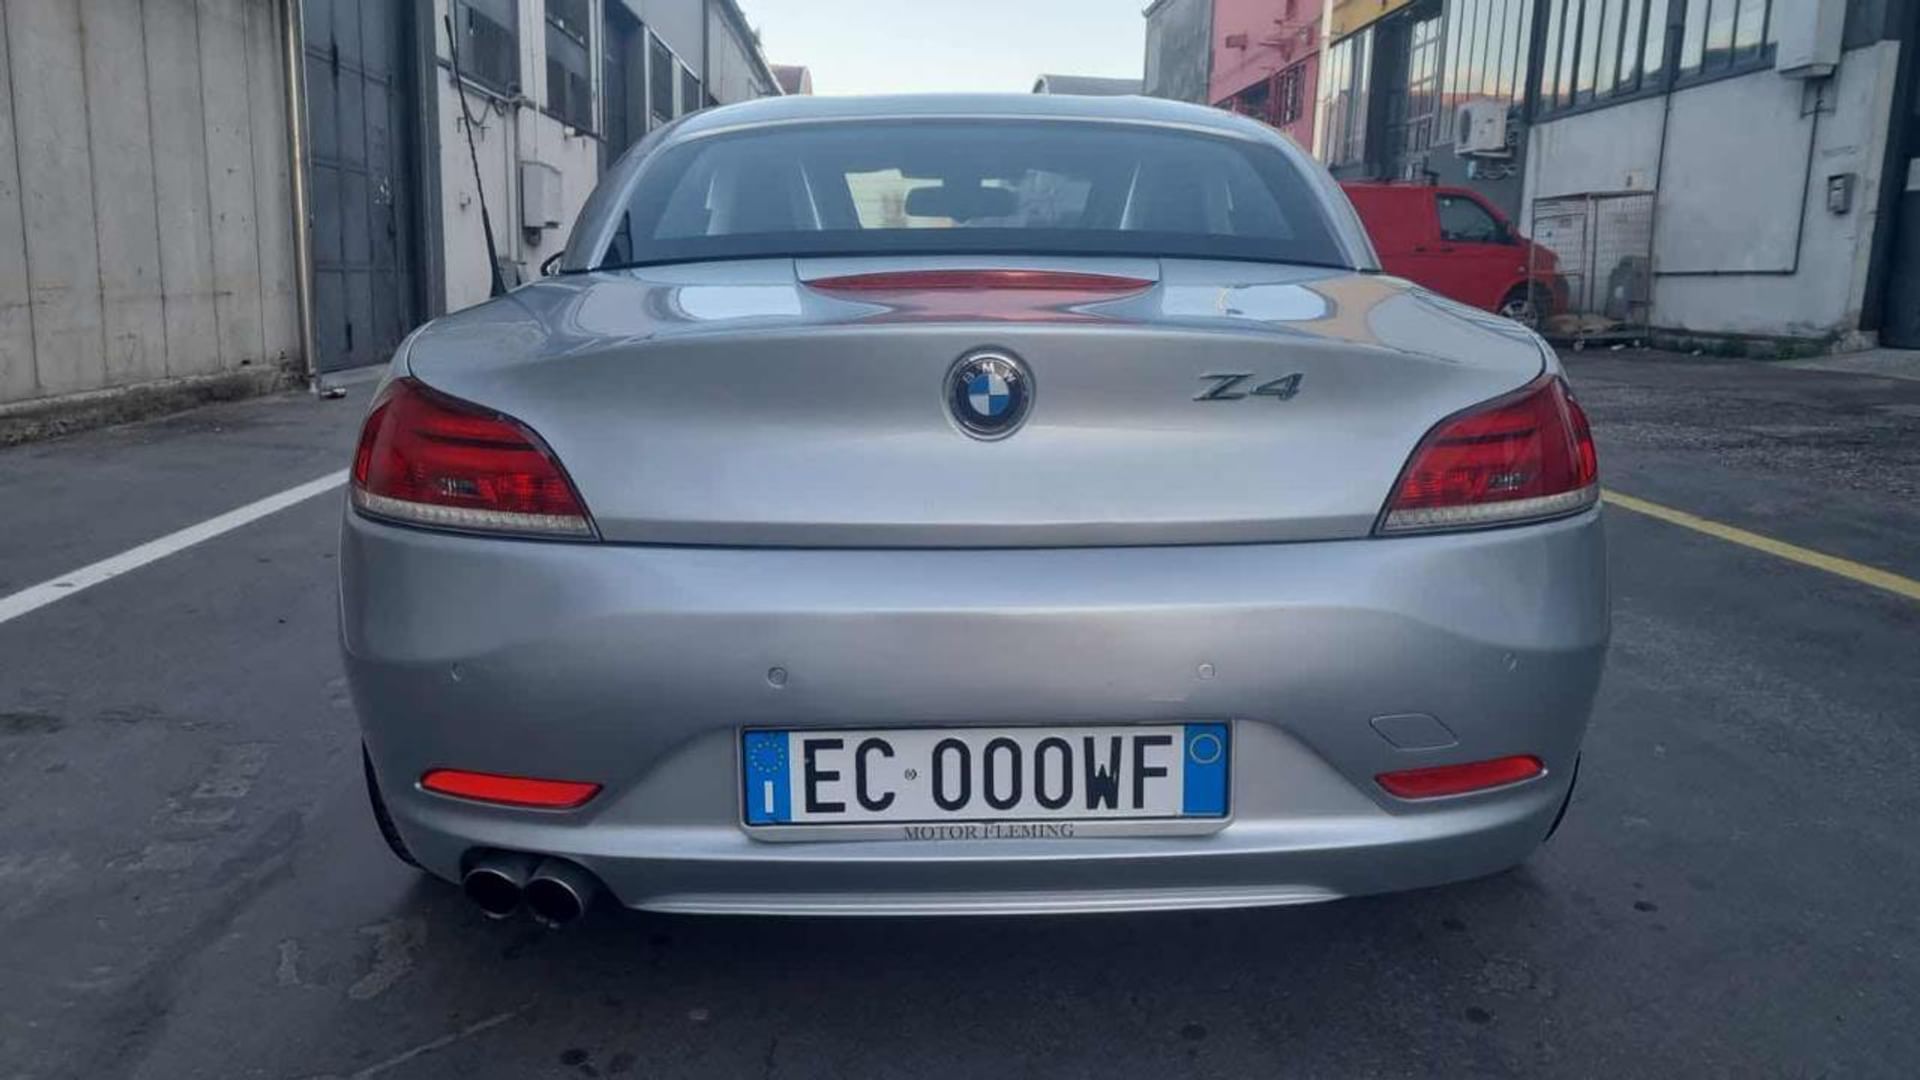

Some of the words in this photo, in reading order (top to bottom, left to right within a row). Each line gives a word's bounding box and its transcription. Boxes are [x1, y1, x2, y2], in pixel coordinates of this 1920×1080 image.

[962, 361, 1017, 384] BMW
[1192, 372, 1304, 401] Z4
[804, 737, 896, 813] EC
[932, 735, 1173, 811] 000WF
[904, 825, 980, 841] MOTOR
[984, 823, 1075, 840] FLEMING
